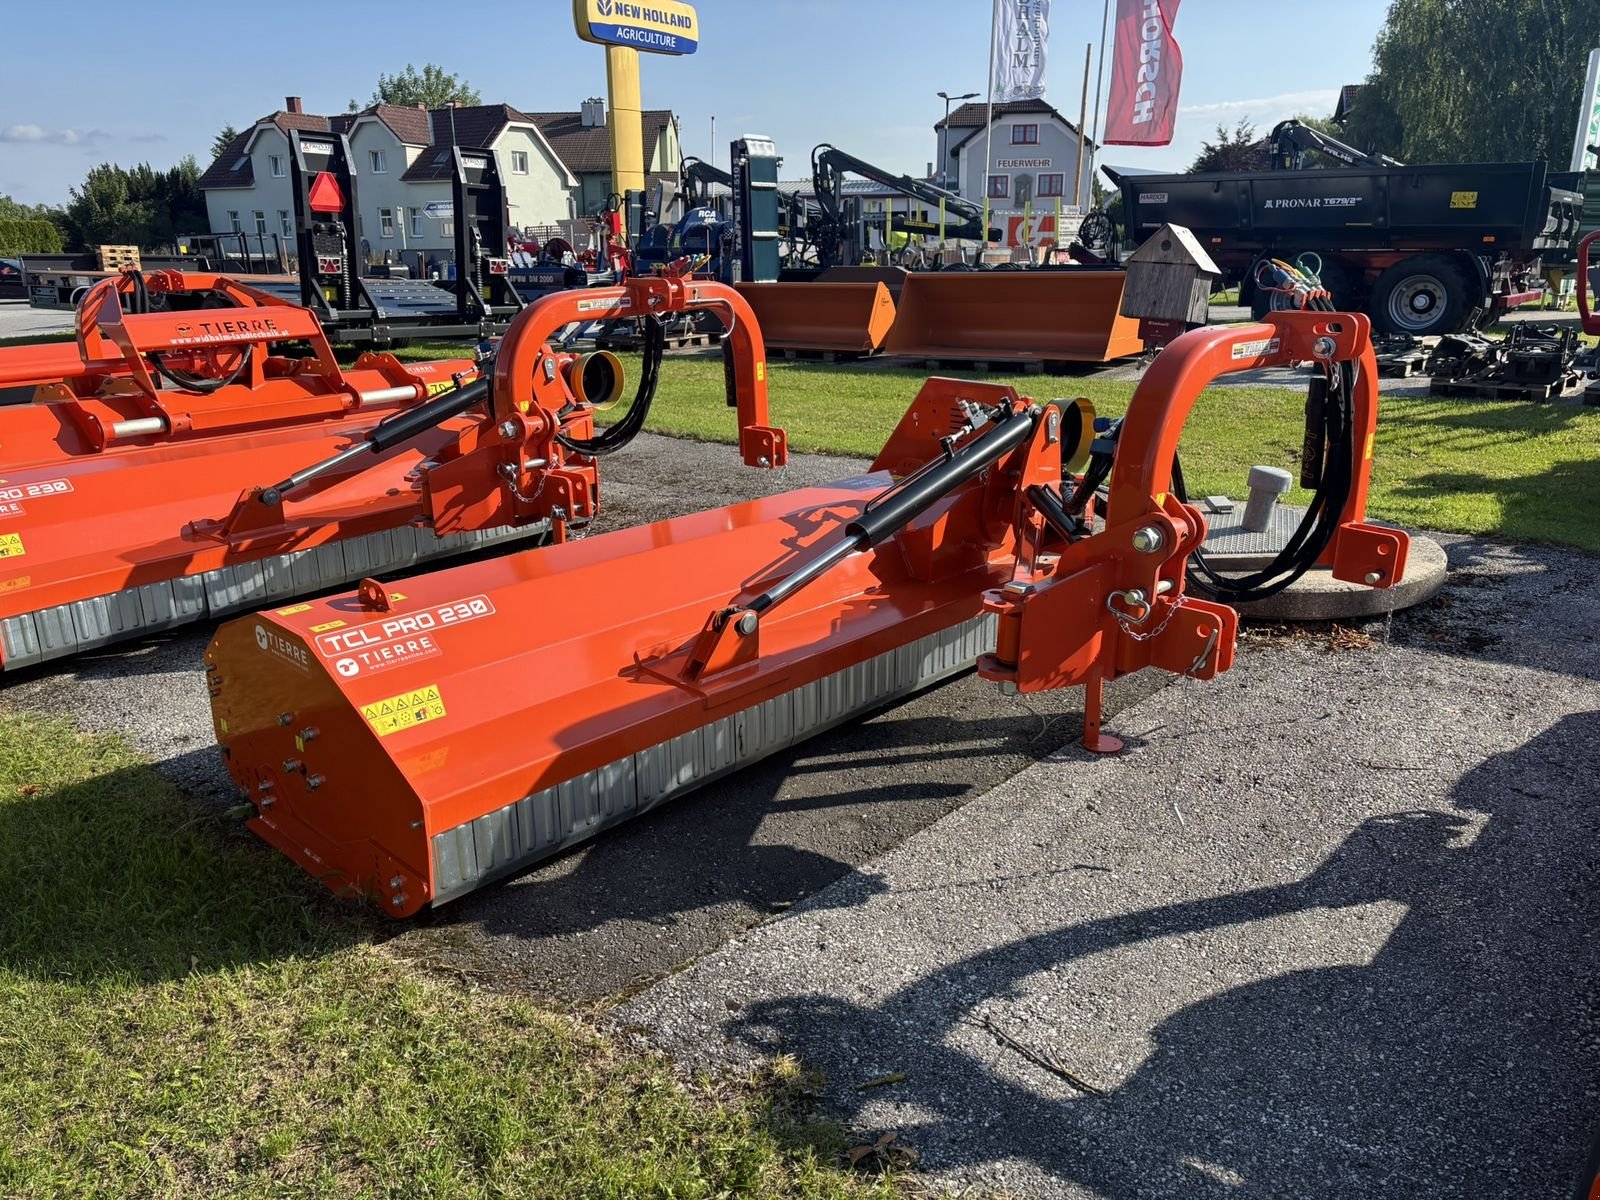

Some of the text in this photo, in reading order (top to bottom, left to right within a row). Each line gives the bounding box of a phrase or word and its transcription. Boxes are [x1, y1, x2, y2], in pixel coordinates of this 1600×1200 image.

[615, 2, 692, 29] NEW HOLLAND
[616, 27, 676, 48] AGRICULTURE
[997, 159, 1050, 168] FEUERWEHR
[734, 187, 741, 200] TT
[1275, 198, 1320, 208] PRONAR
[698, 210, 716, 218] RCA
[540, 275, 554, 283] 2000
[199, 319, 277, 334] TIERRE
[170, 329, 289, 345] www.widhalm-landtechnik.at
[26, 481, 68, 496] 230
[324, 599, 489, 652] TCL PRO 230
[266, 631, 308, 665] TIERRE
[358, 637, 433, 665] TIERRE
[368, 647, 439, 671] www.tierreonline.com
